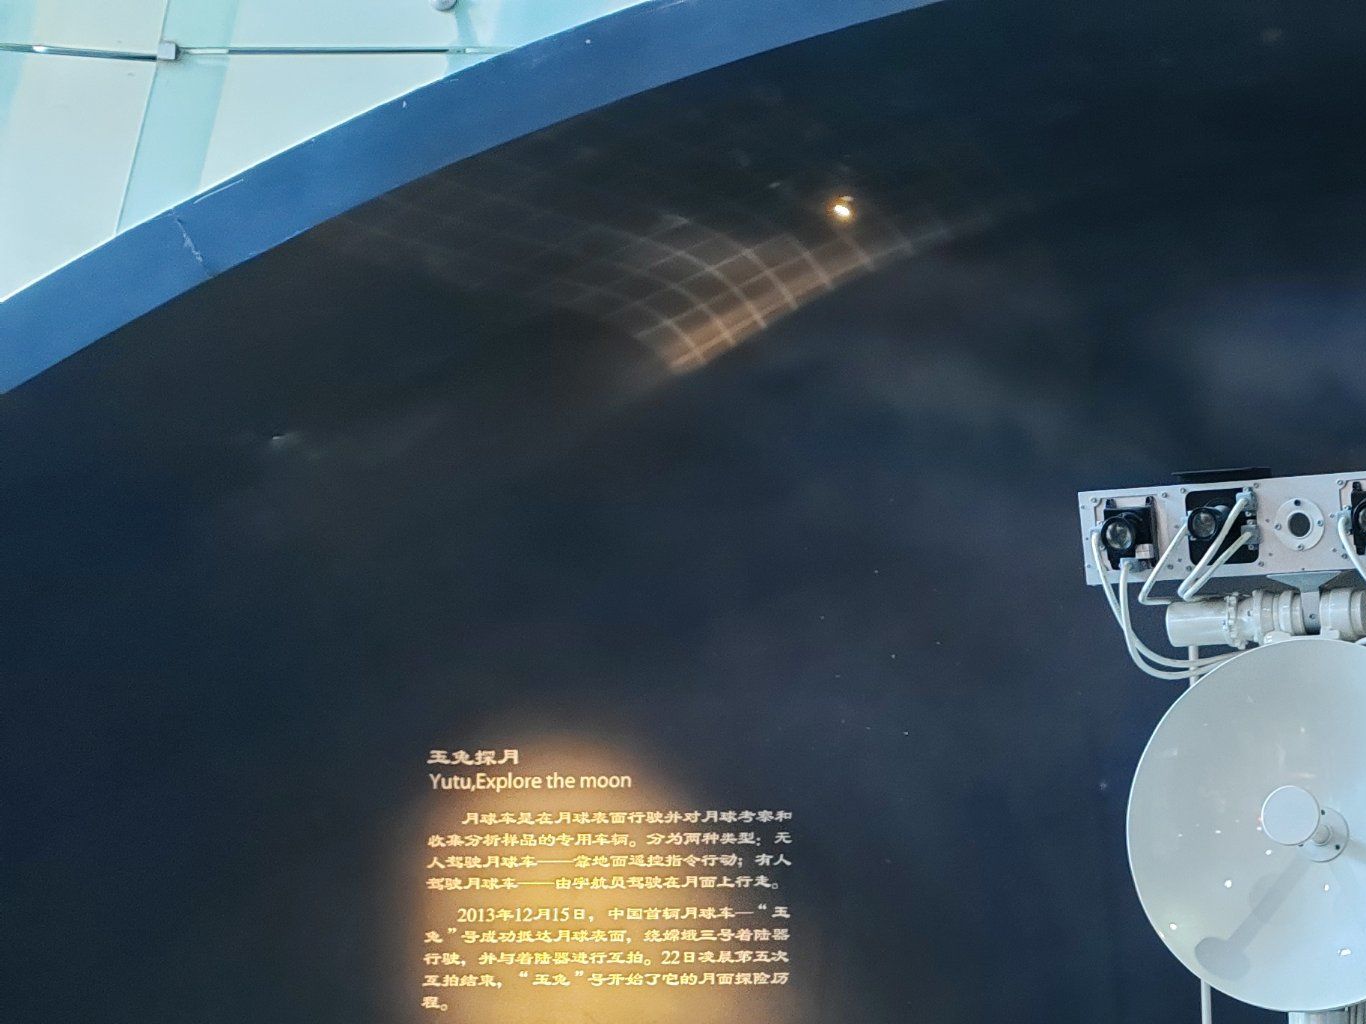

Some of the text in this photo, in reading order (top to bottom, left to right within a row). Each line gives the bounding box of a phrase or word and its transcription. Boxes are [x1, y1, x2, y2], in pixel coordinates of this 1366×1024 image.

[427, 749, 519, 766] 玉兔探月
[429, 772, 632, 793] Yutu,Explore the moon
